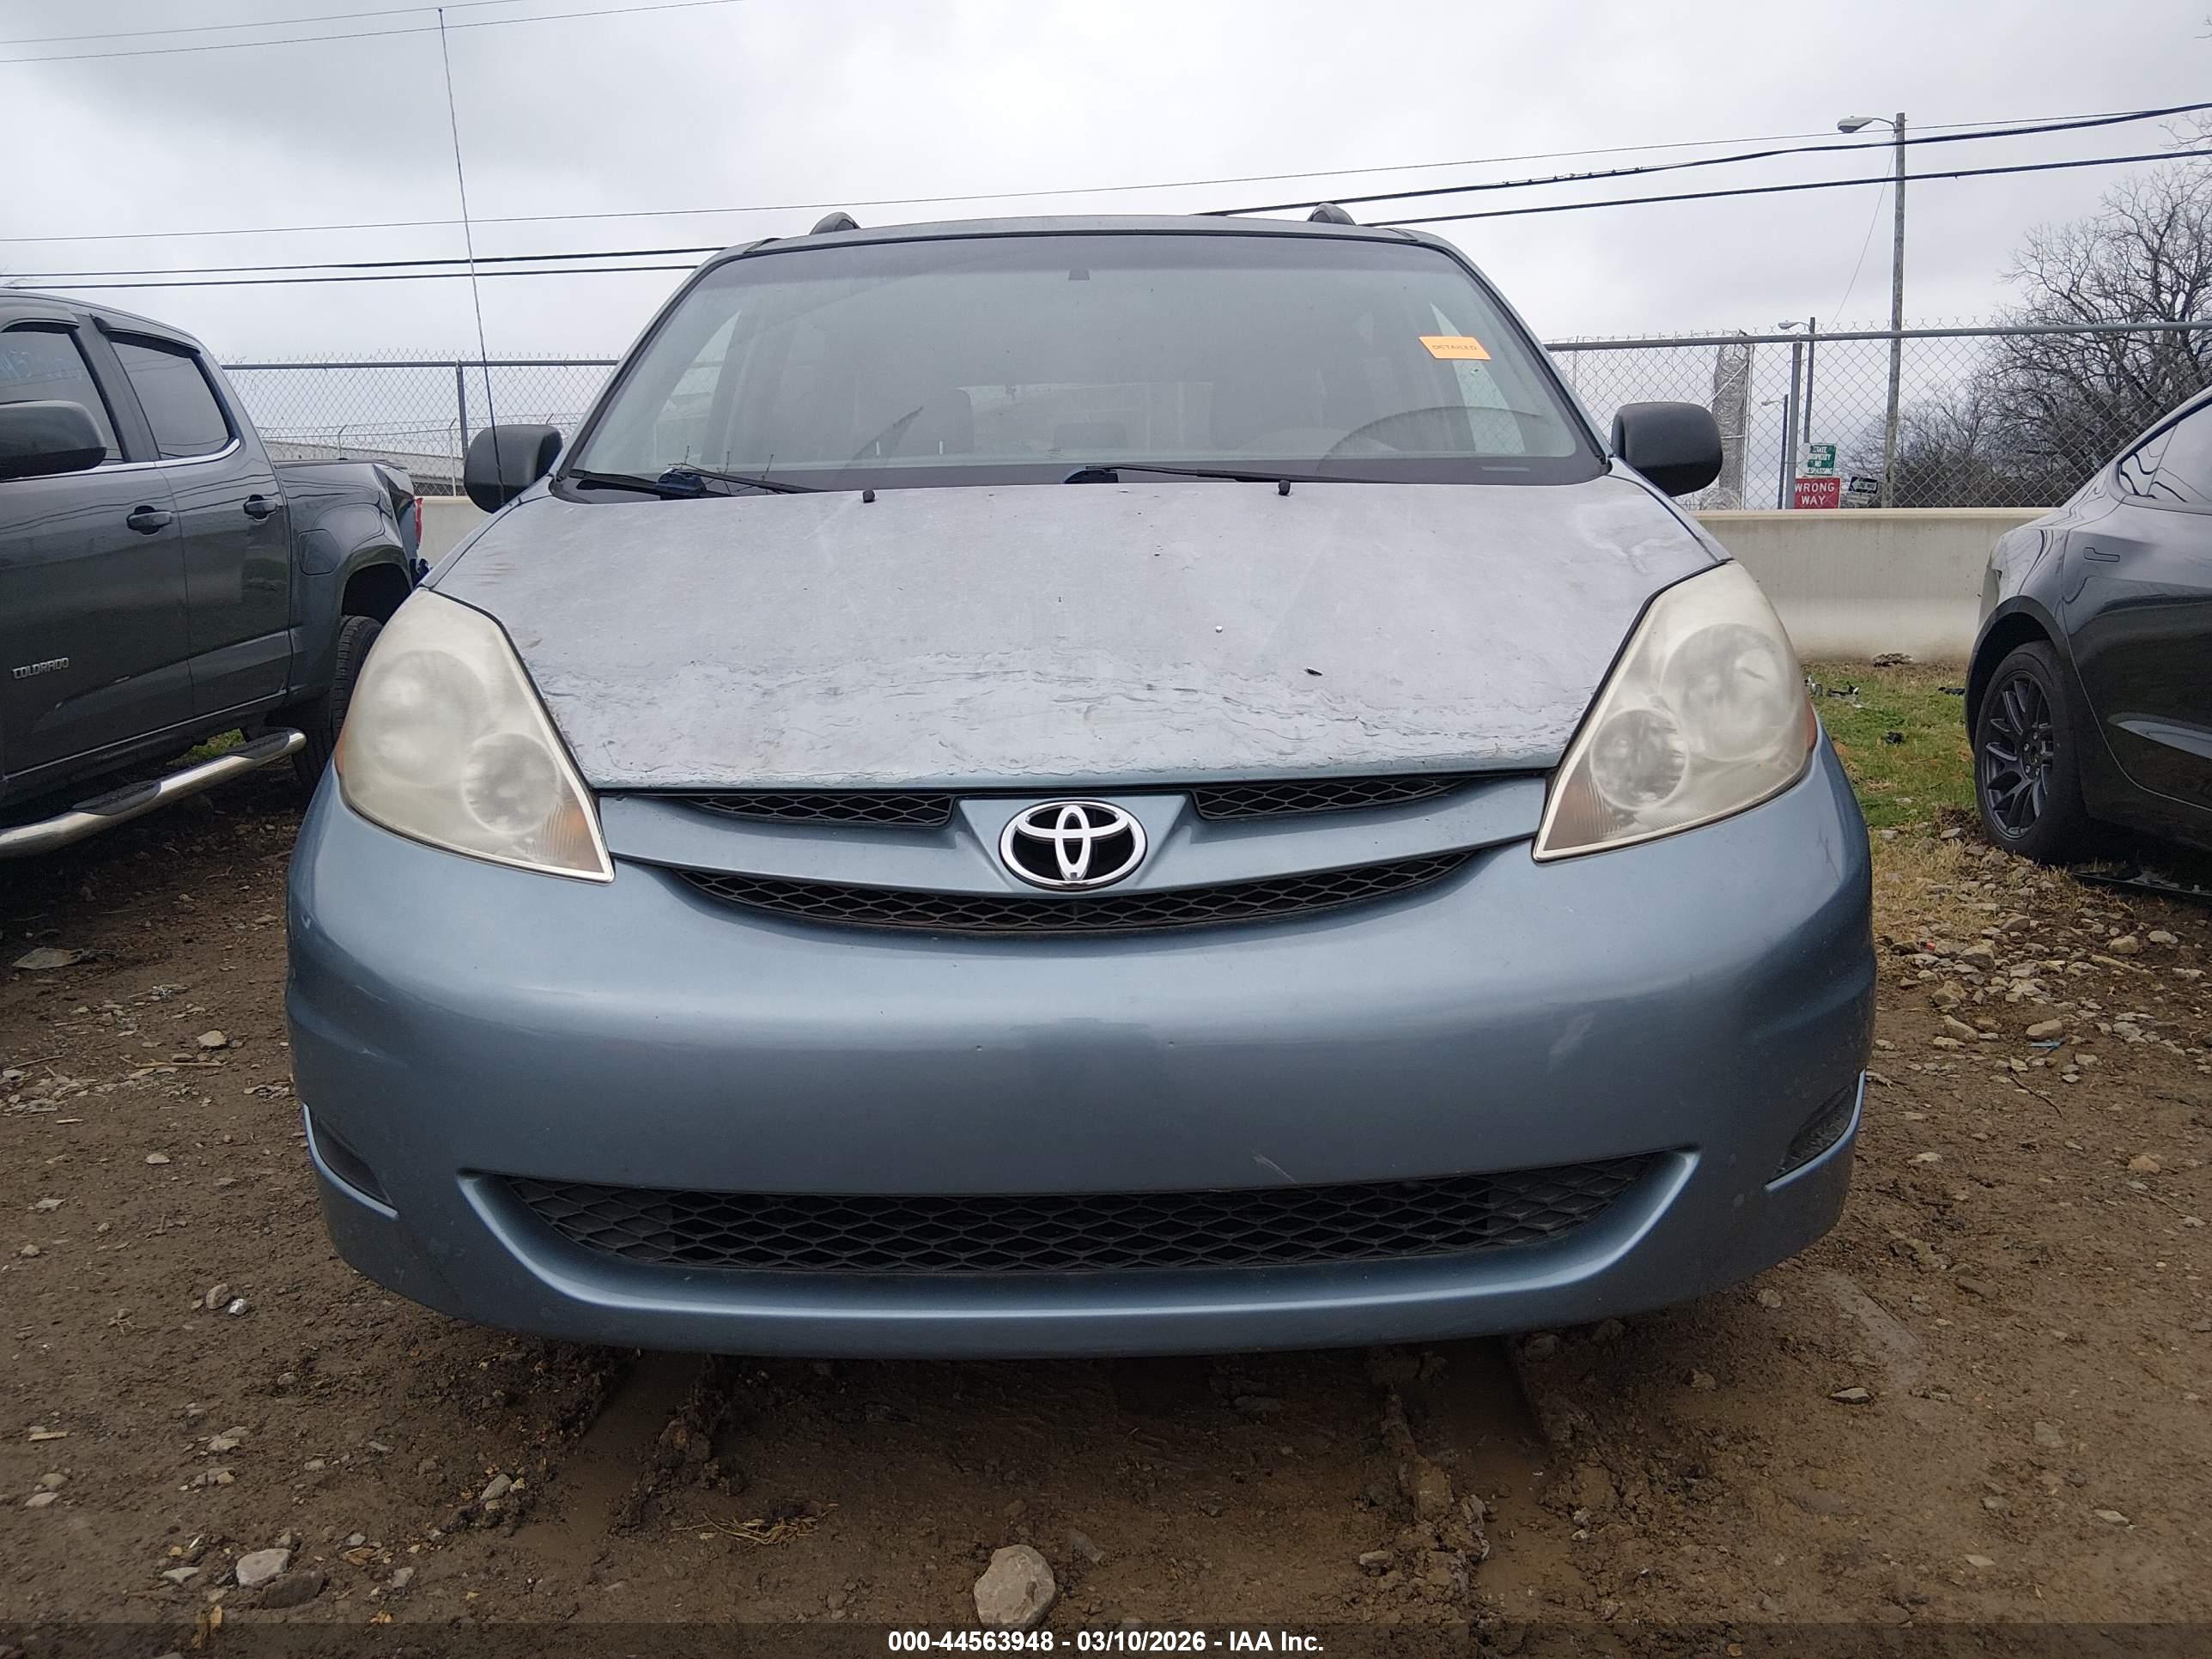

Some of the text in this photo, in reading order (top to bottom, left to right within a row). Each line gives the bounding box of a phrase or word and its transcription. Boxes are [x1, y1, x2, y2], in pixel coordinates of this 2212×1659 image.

[1795, 482, 1835, 493] WRONG
[1801, 495, 1826, 506] WAY
[12, 657, 69, 679] COLORADO
